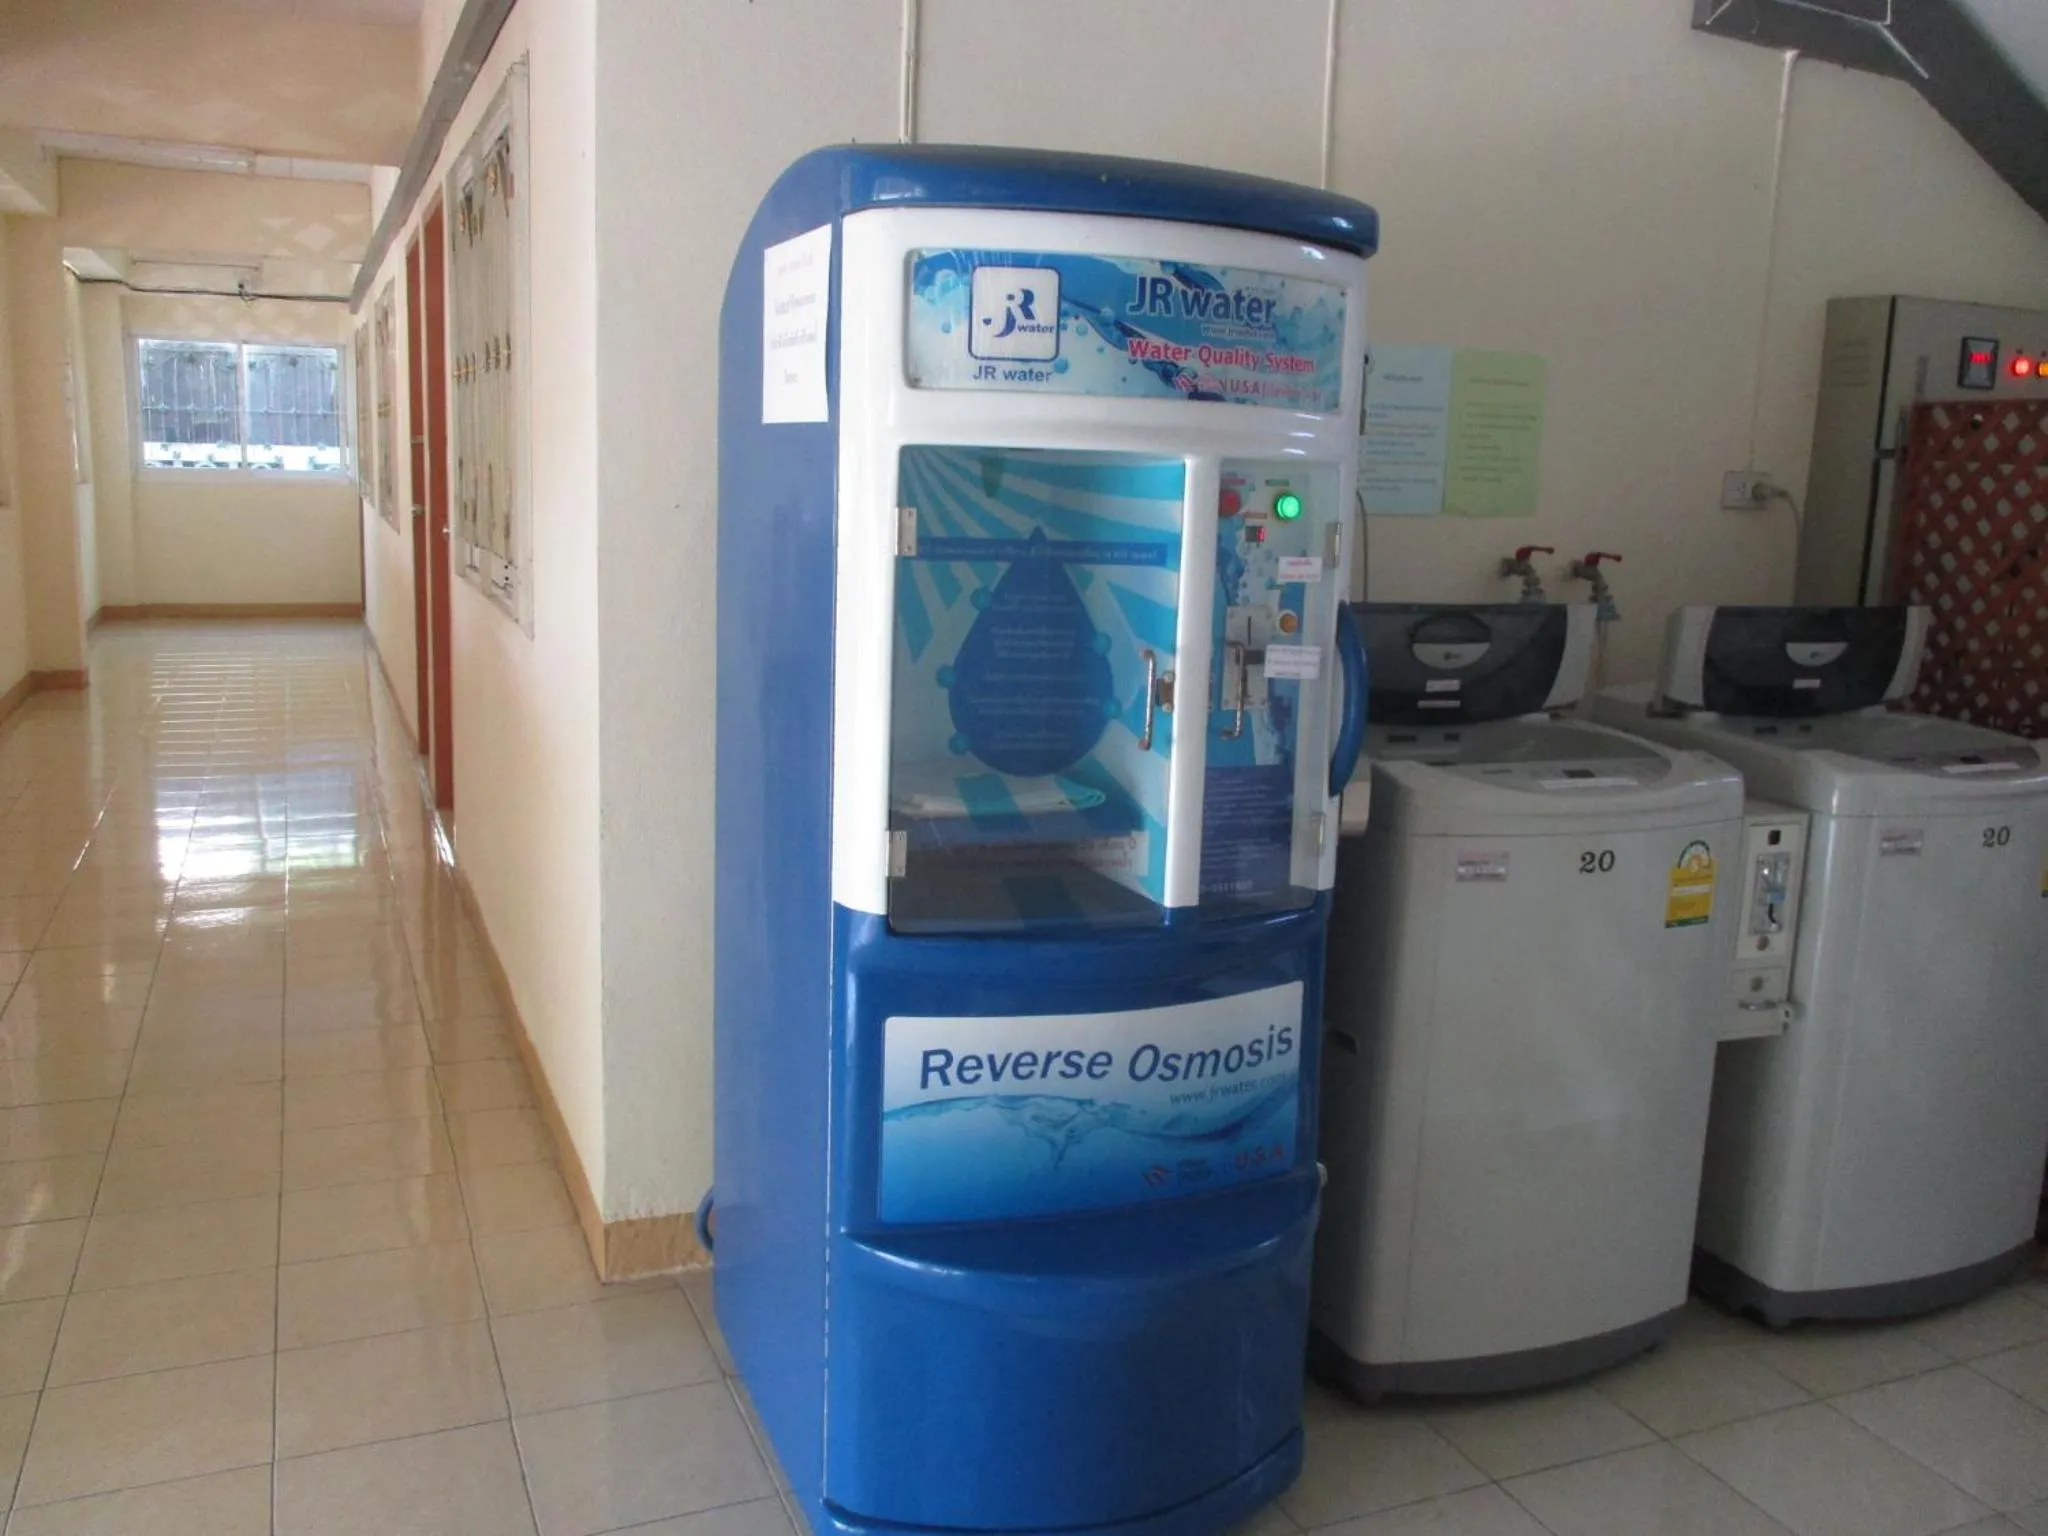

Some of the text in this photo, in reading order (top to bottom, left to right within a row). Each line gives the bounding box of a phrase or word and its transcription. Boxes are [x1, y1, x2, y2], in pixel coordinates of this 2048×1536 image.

[1128, 276, 1277, 325] JR water
[1017, 323, 1054, 334] water
[1129, 339, 1315, 373] Water Quality System
[972, 365, 1053, 382] JR water
[1982, 825, 2010, 848] 20
[1579, 850, 1615, 874] 20
[919, 1024, 1293, 1090] Reverse Osmosis
